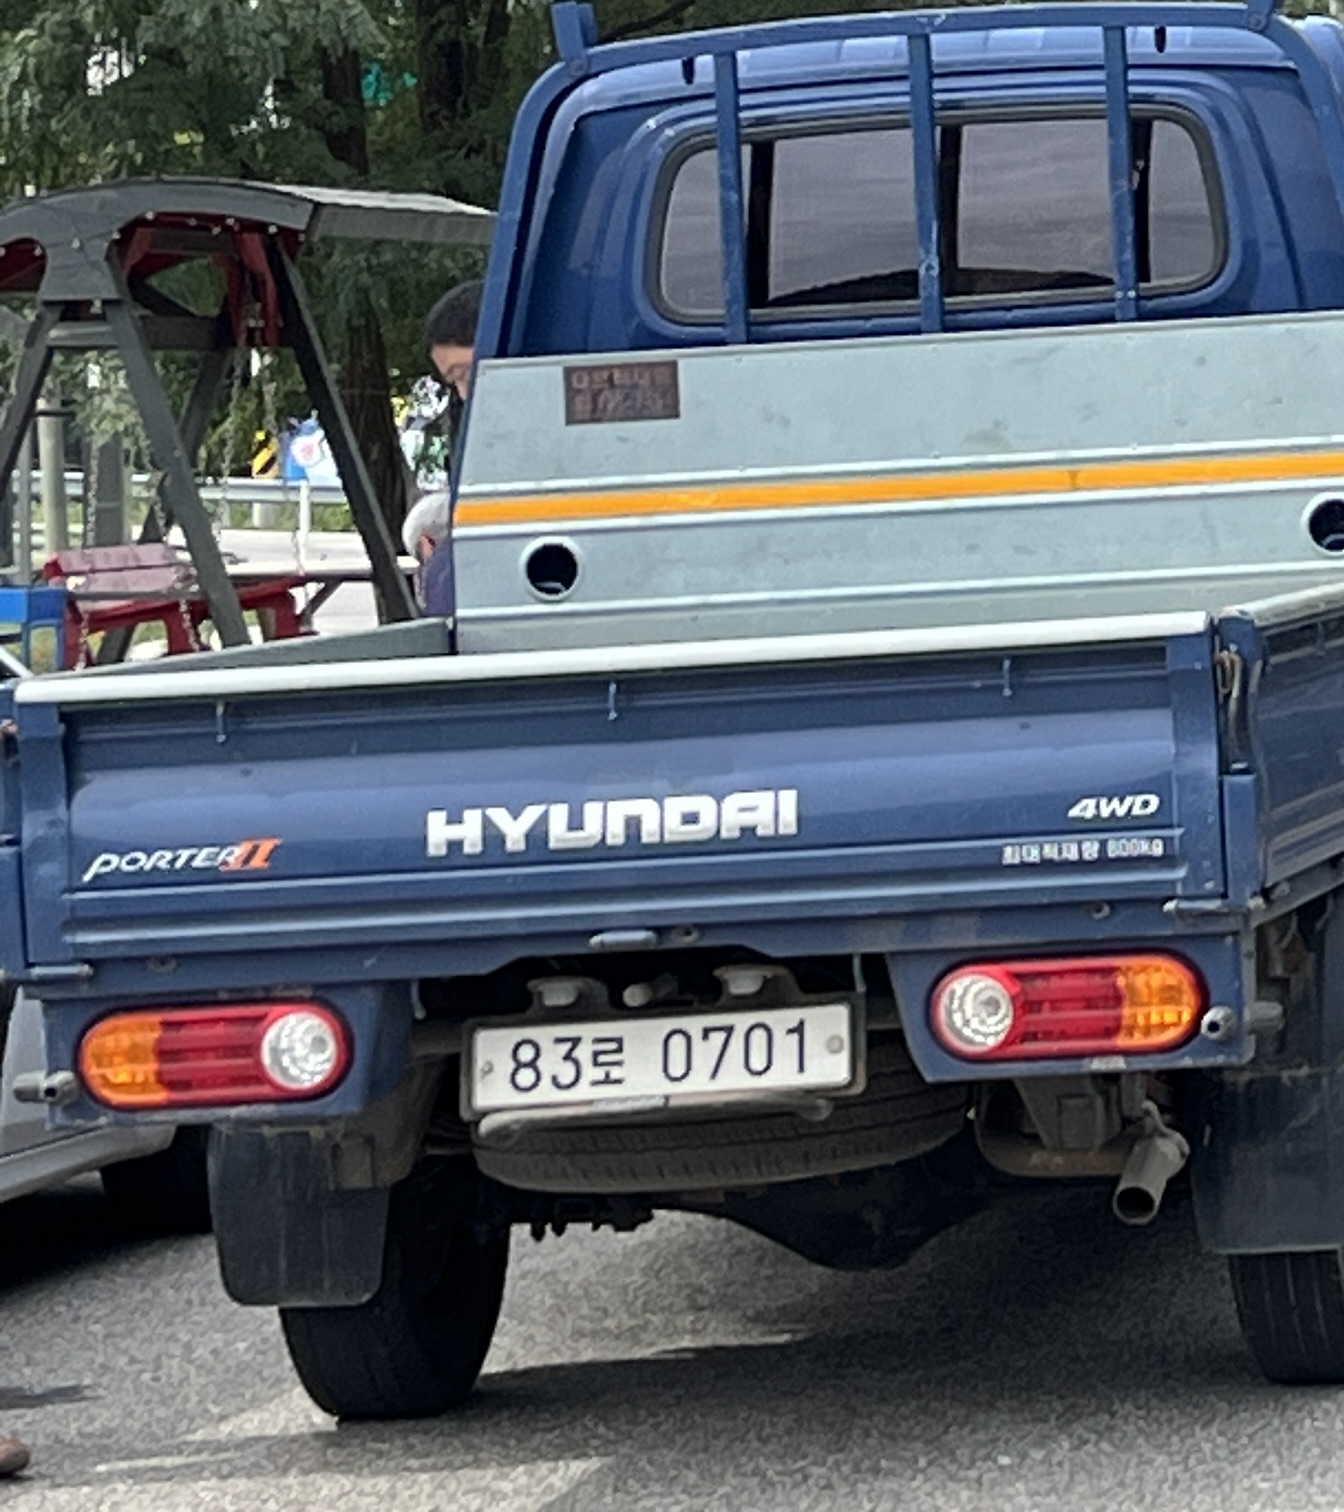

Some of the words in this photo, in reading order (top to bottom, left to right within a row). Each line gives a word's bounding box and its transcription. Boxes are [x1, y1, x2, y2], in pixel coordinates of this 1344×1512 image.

[426, 789, 798, 858] HYUNDAI
[1067, 793, 1161, 819] 4WD
[509, 1035, 625, 1092] 83로
[661, 1018, 807, 1083] 0701
